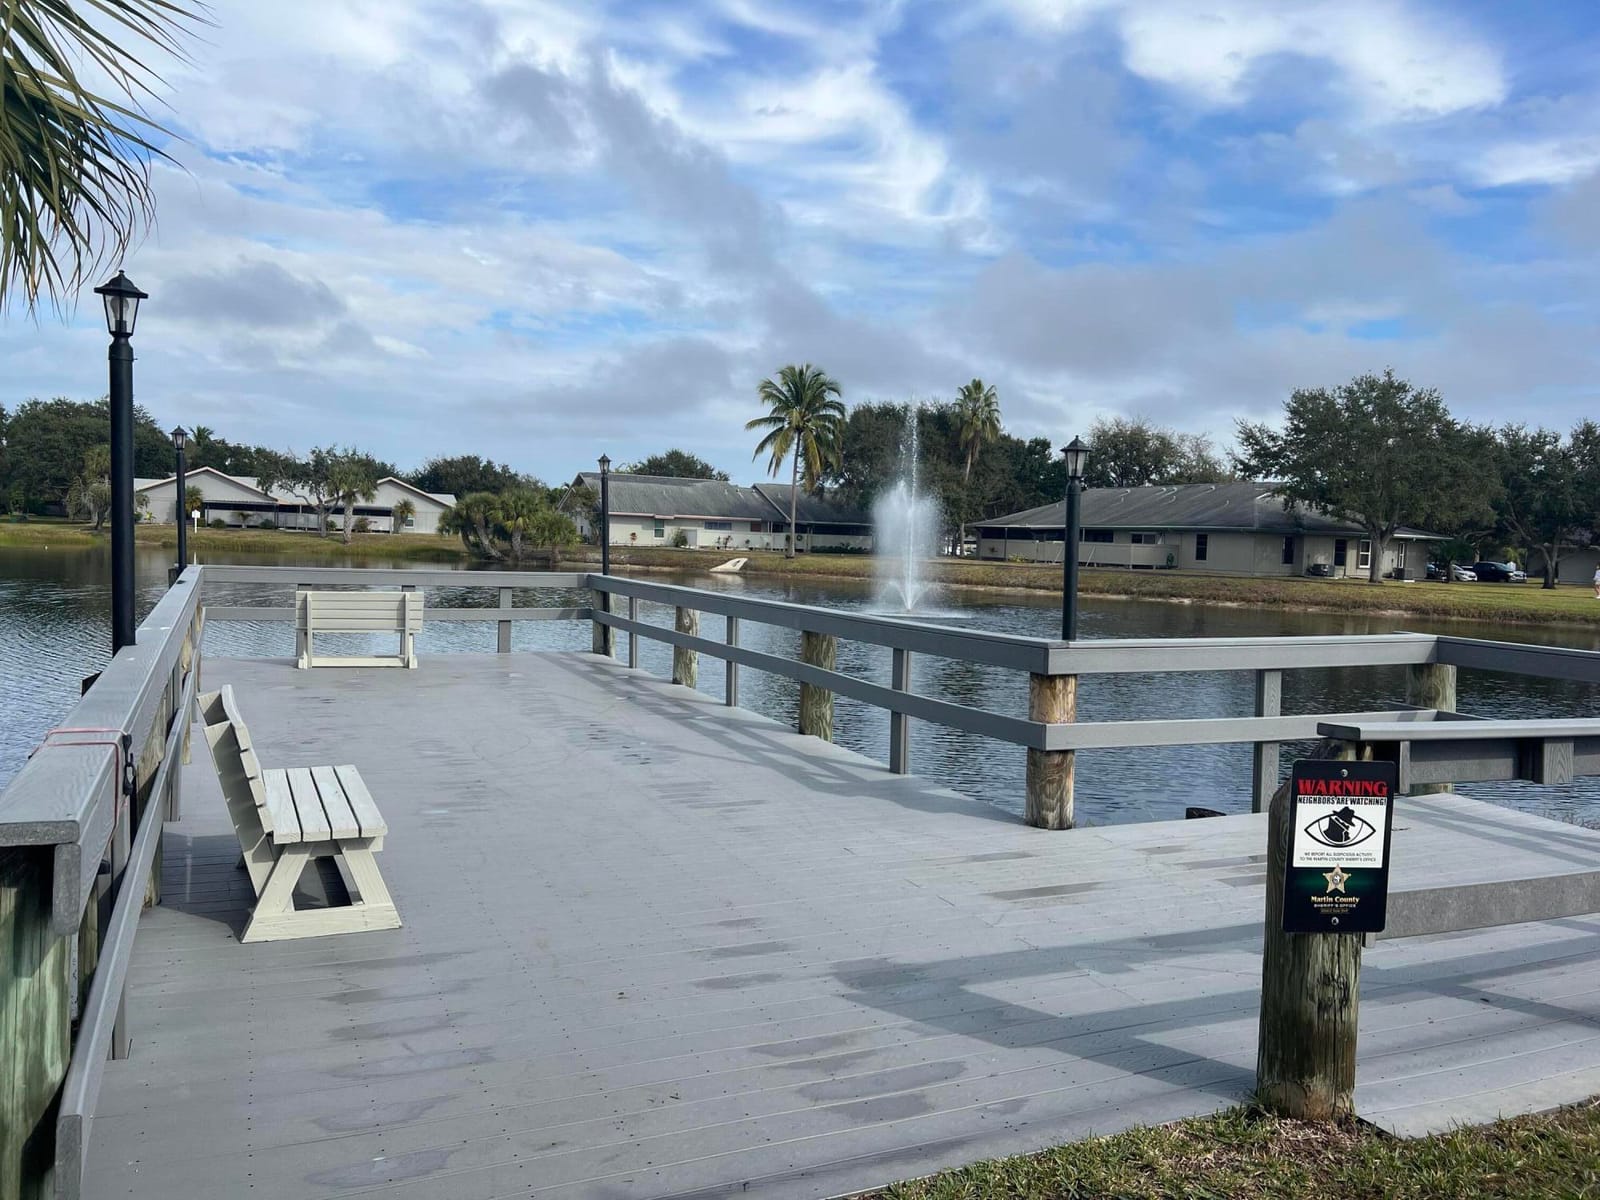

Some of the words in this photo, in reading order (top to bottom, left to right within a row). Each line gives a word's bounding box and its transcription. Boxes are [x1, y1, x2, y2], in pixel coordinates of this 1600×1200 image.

[1298, 779, 1388, 796] WARNING
[1350, 797, 1386, 806] WATCHING!
[1334, 896, 1360, 904] County
